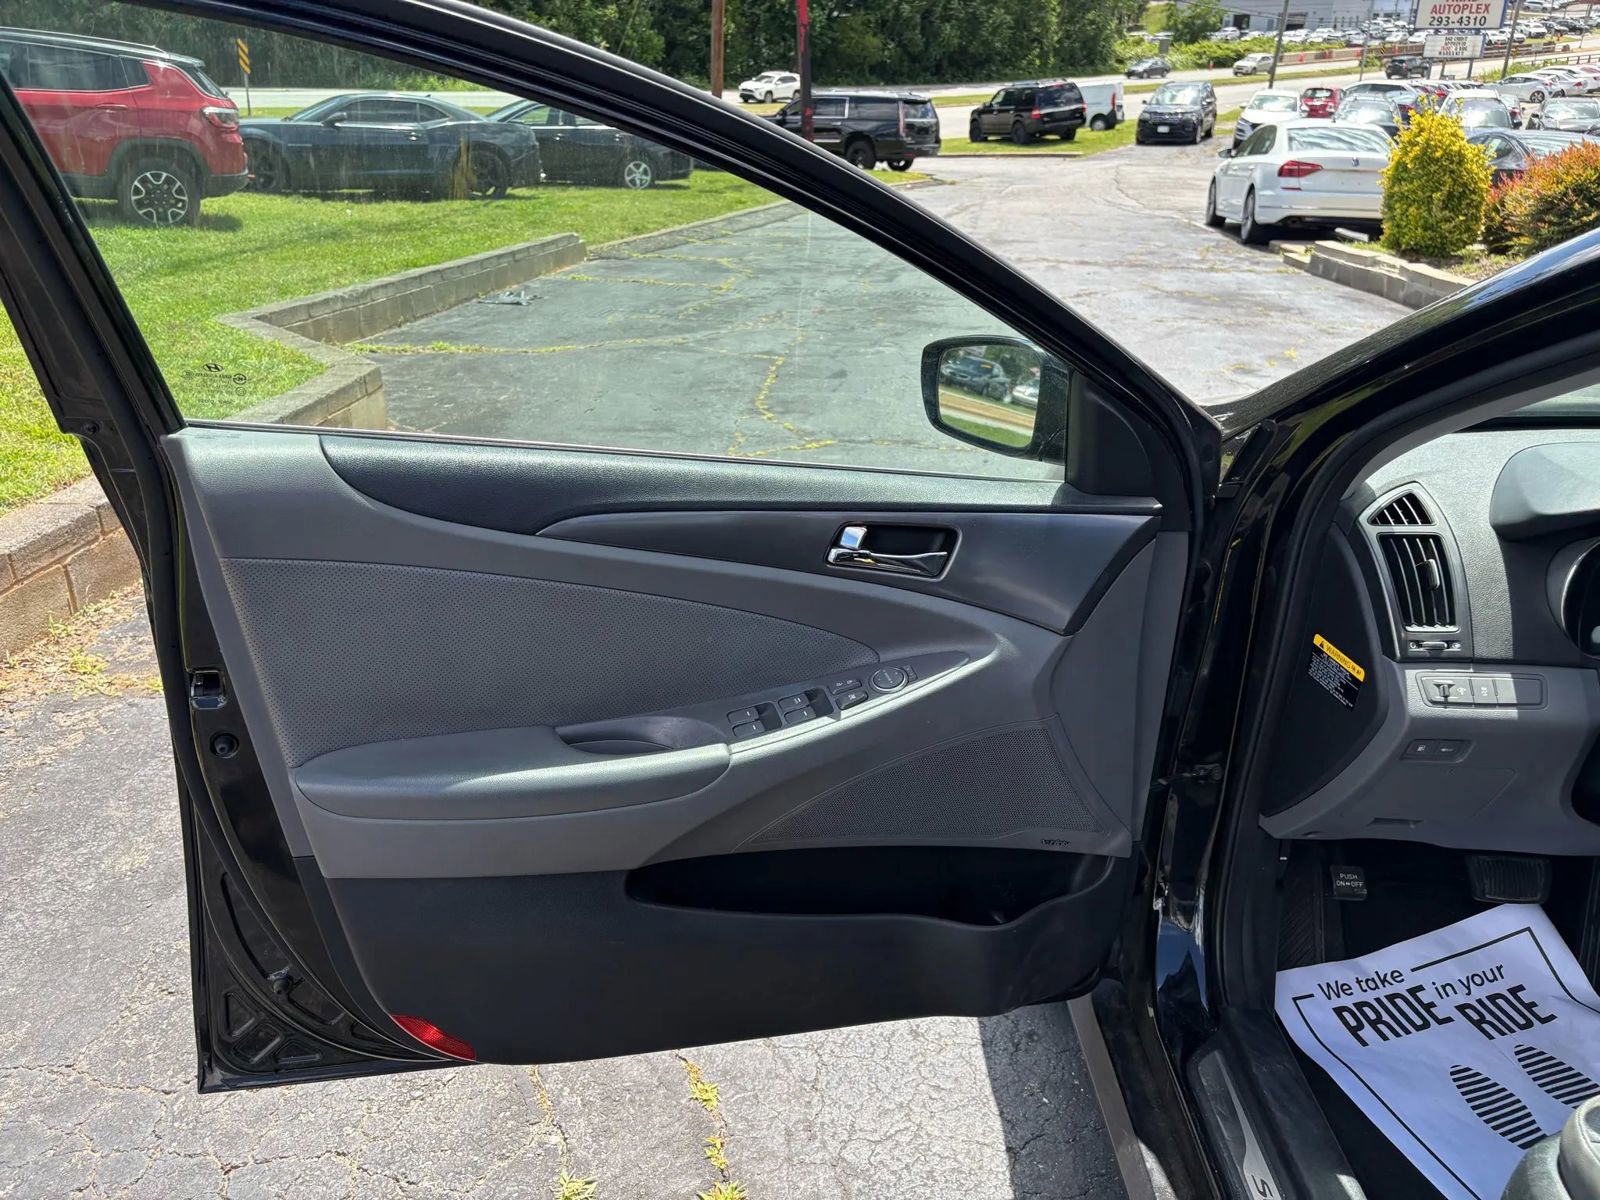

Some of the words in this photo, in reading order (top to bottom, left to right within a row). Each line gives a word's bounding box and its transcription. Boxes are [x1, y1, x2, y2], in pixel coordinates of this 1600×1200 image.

[1429, 15, 1487, 26] 293-4310
[1430, 4, 1491, 14] AUTOPLEX
[1326, 644, 1351, 669] WARNING
[1339, 872, 1358, 880] PUSH
[1317, 980, 1353, 1000] We
[1355, 968, 1405, 993] take
[1432, 980, 1457, 1000] in
[1458, 963, 1505, 996] your
[1332, 984, 1455, 1047] PRIDE
[1454, 984, 1558, 1040] RIDE
